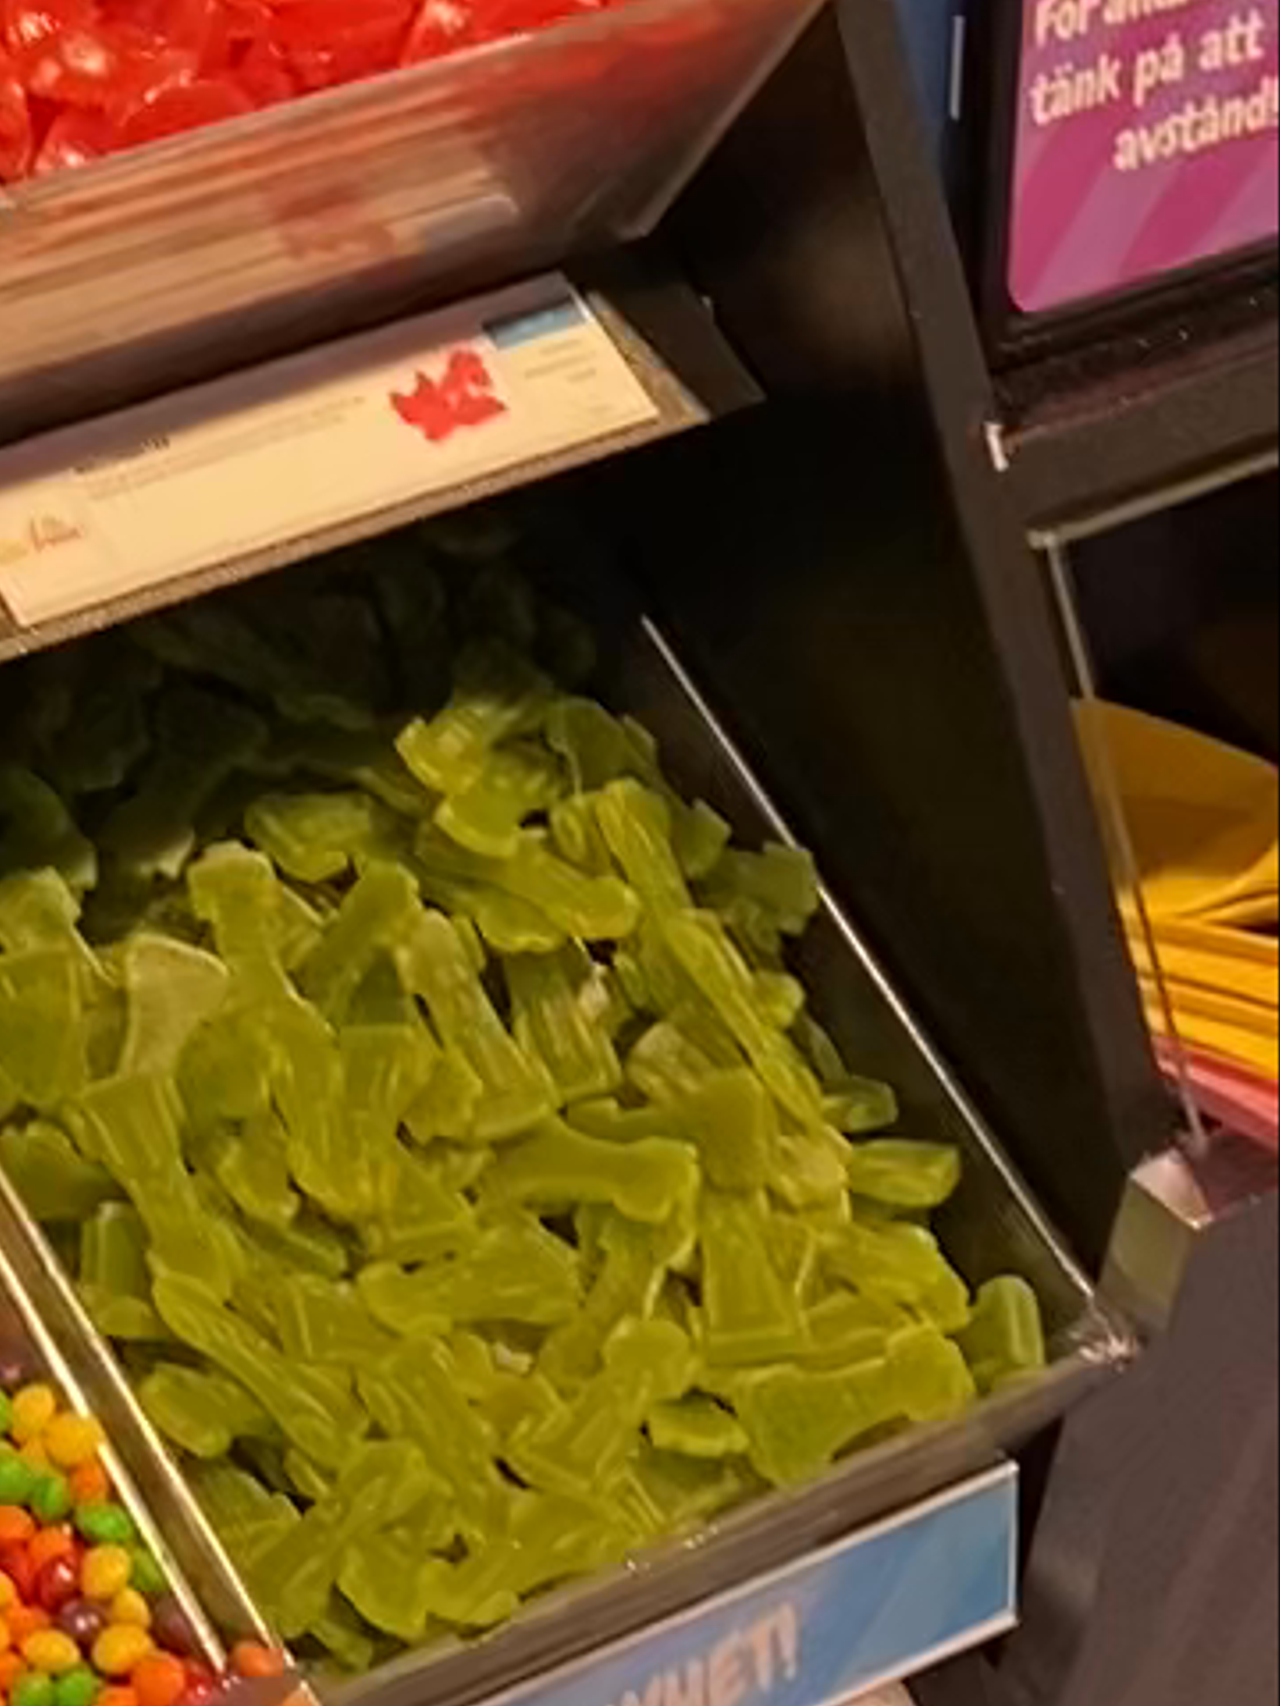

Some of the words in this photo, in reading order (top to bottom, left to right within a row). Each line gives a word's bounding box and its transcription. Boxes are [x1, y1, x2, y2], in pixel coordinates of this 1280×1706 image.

[1030, 52, 1121, 127] tänk
[1134, 34, 1184, 108] på
[1199, 8, 1264, 71] att
